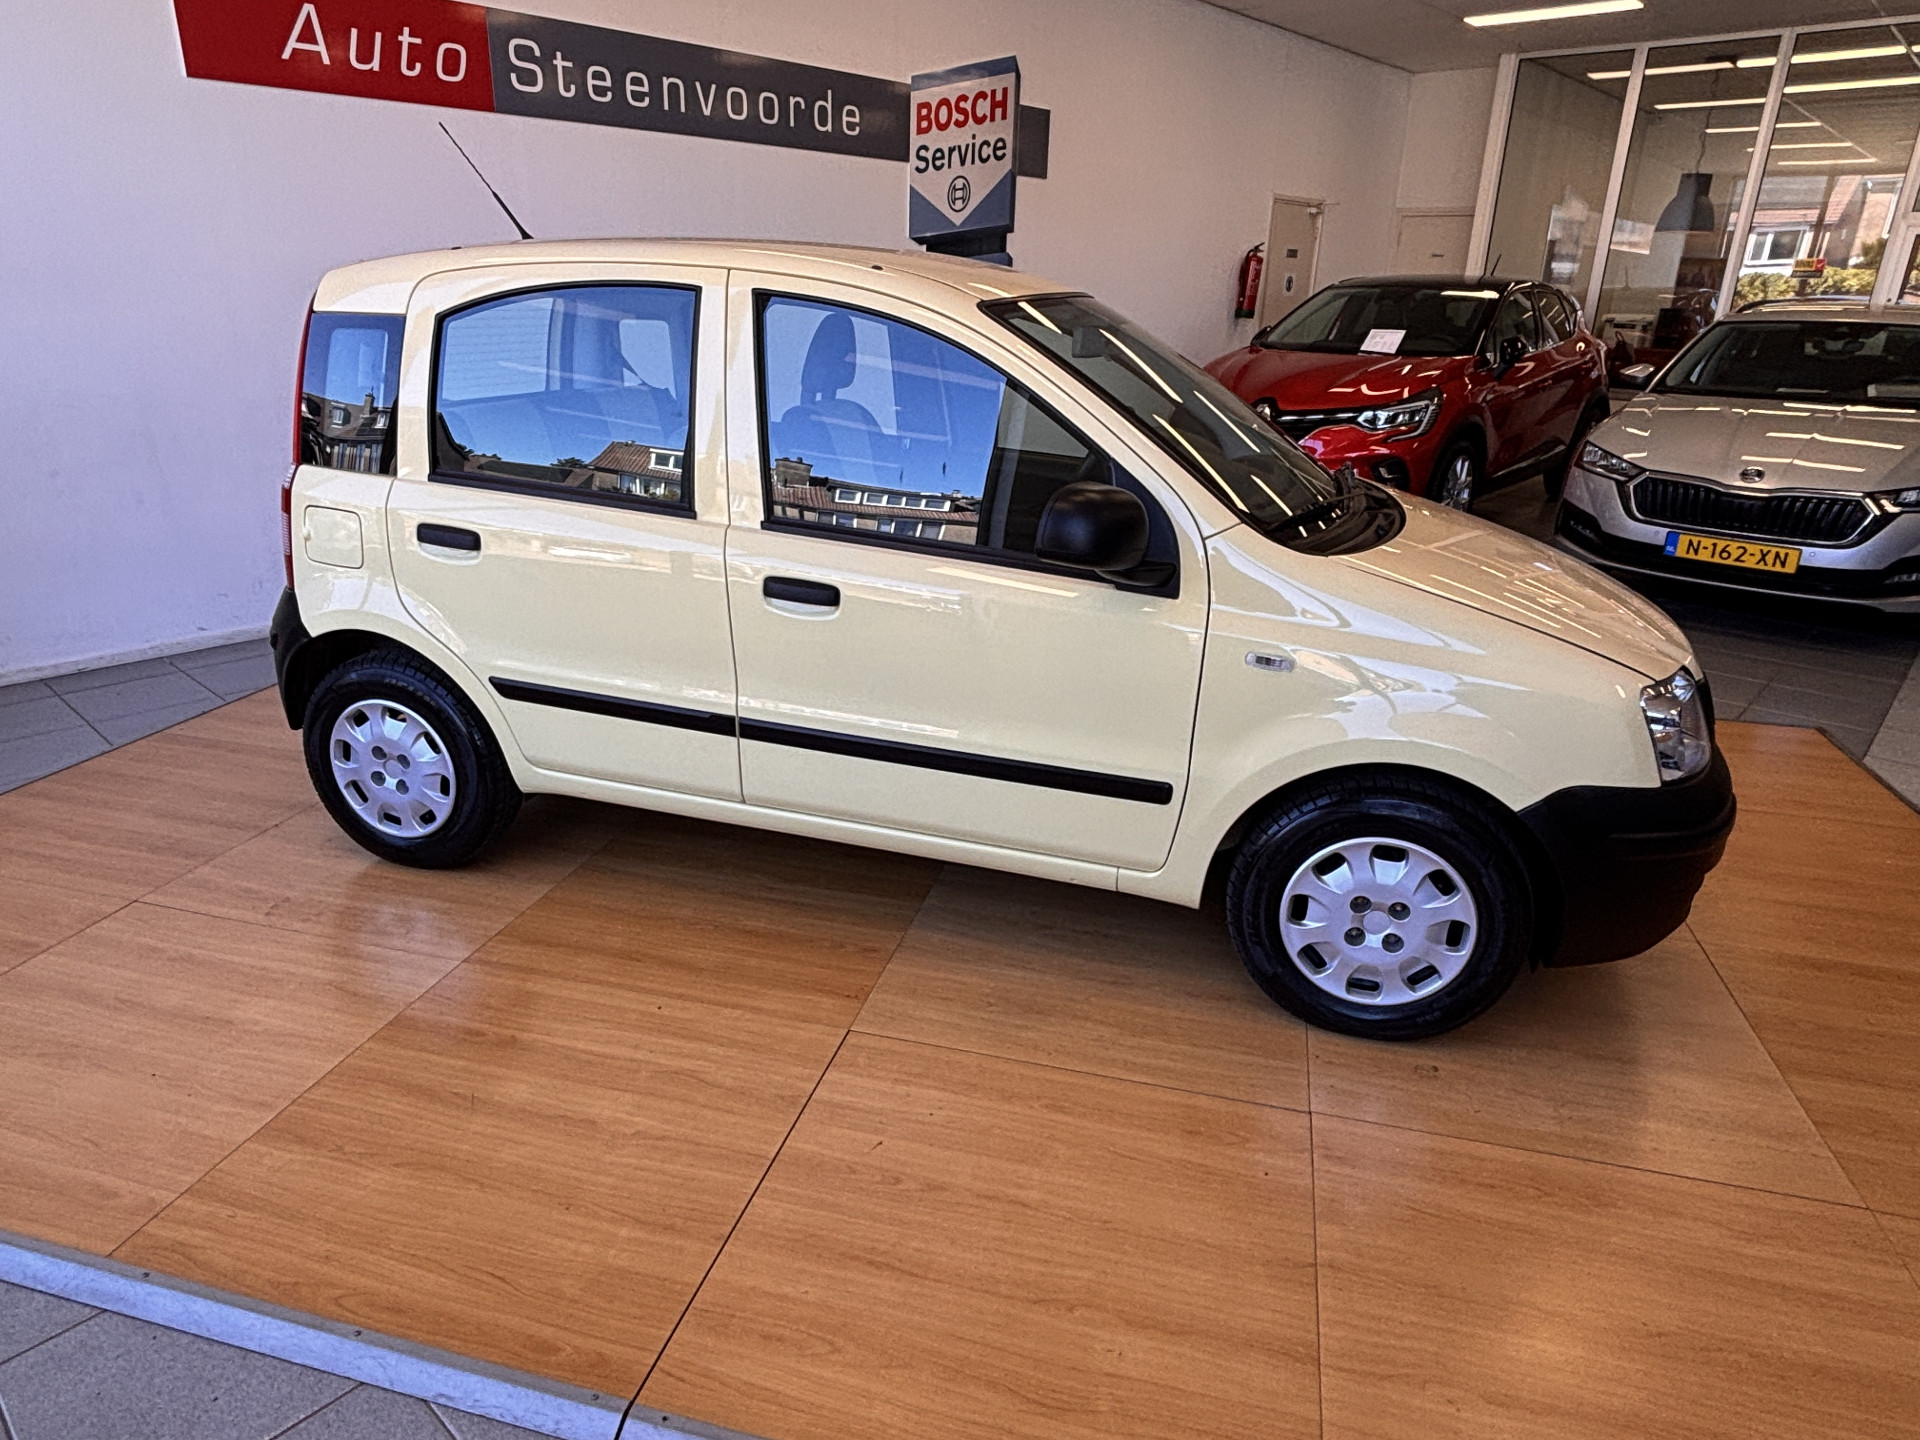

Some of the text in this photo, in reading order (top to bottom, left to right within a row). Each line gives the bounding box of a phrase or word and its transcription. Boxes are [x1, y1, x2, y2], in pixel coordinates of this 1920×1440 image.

[281, 3, 861, 136] Auto Steenvoorde
[916, 86, 1009, 136] BOSCH
[914, 133, 1007, 174] Service
[1685, 538, 1789, 569] N-162-XN
